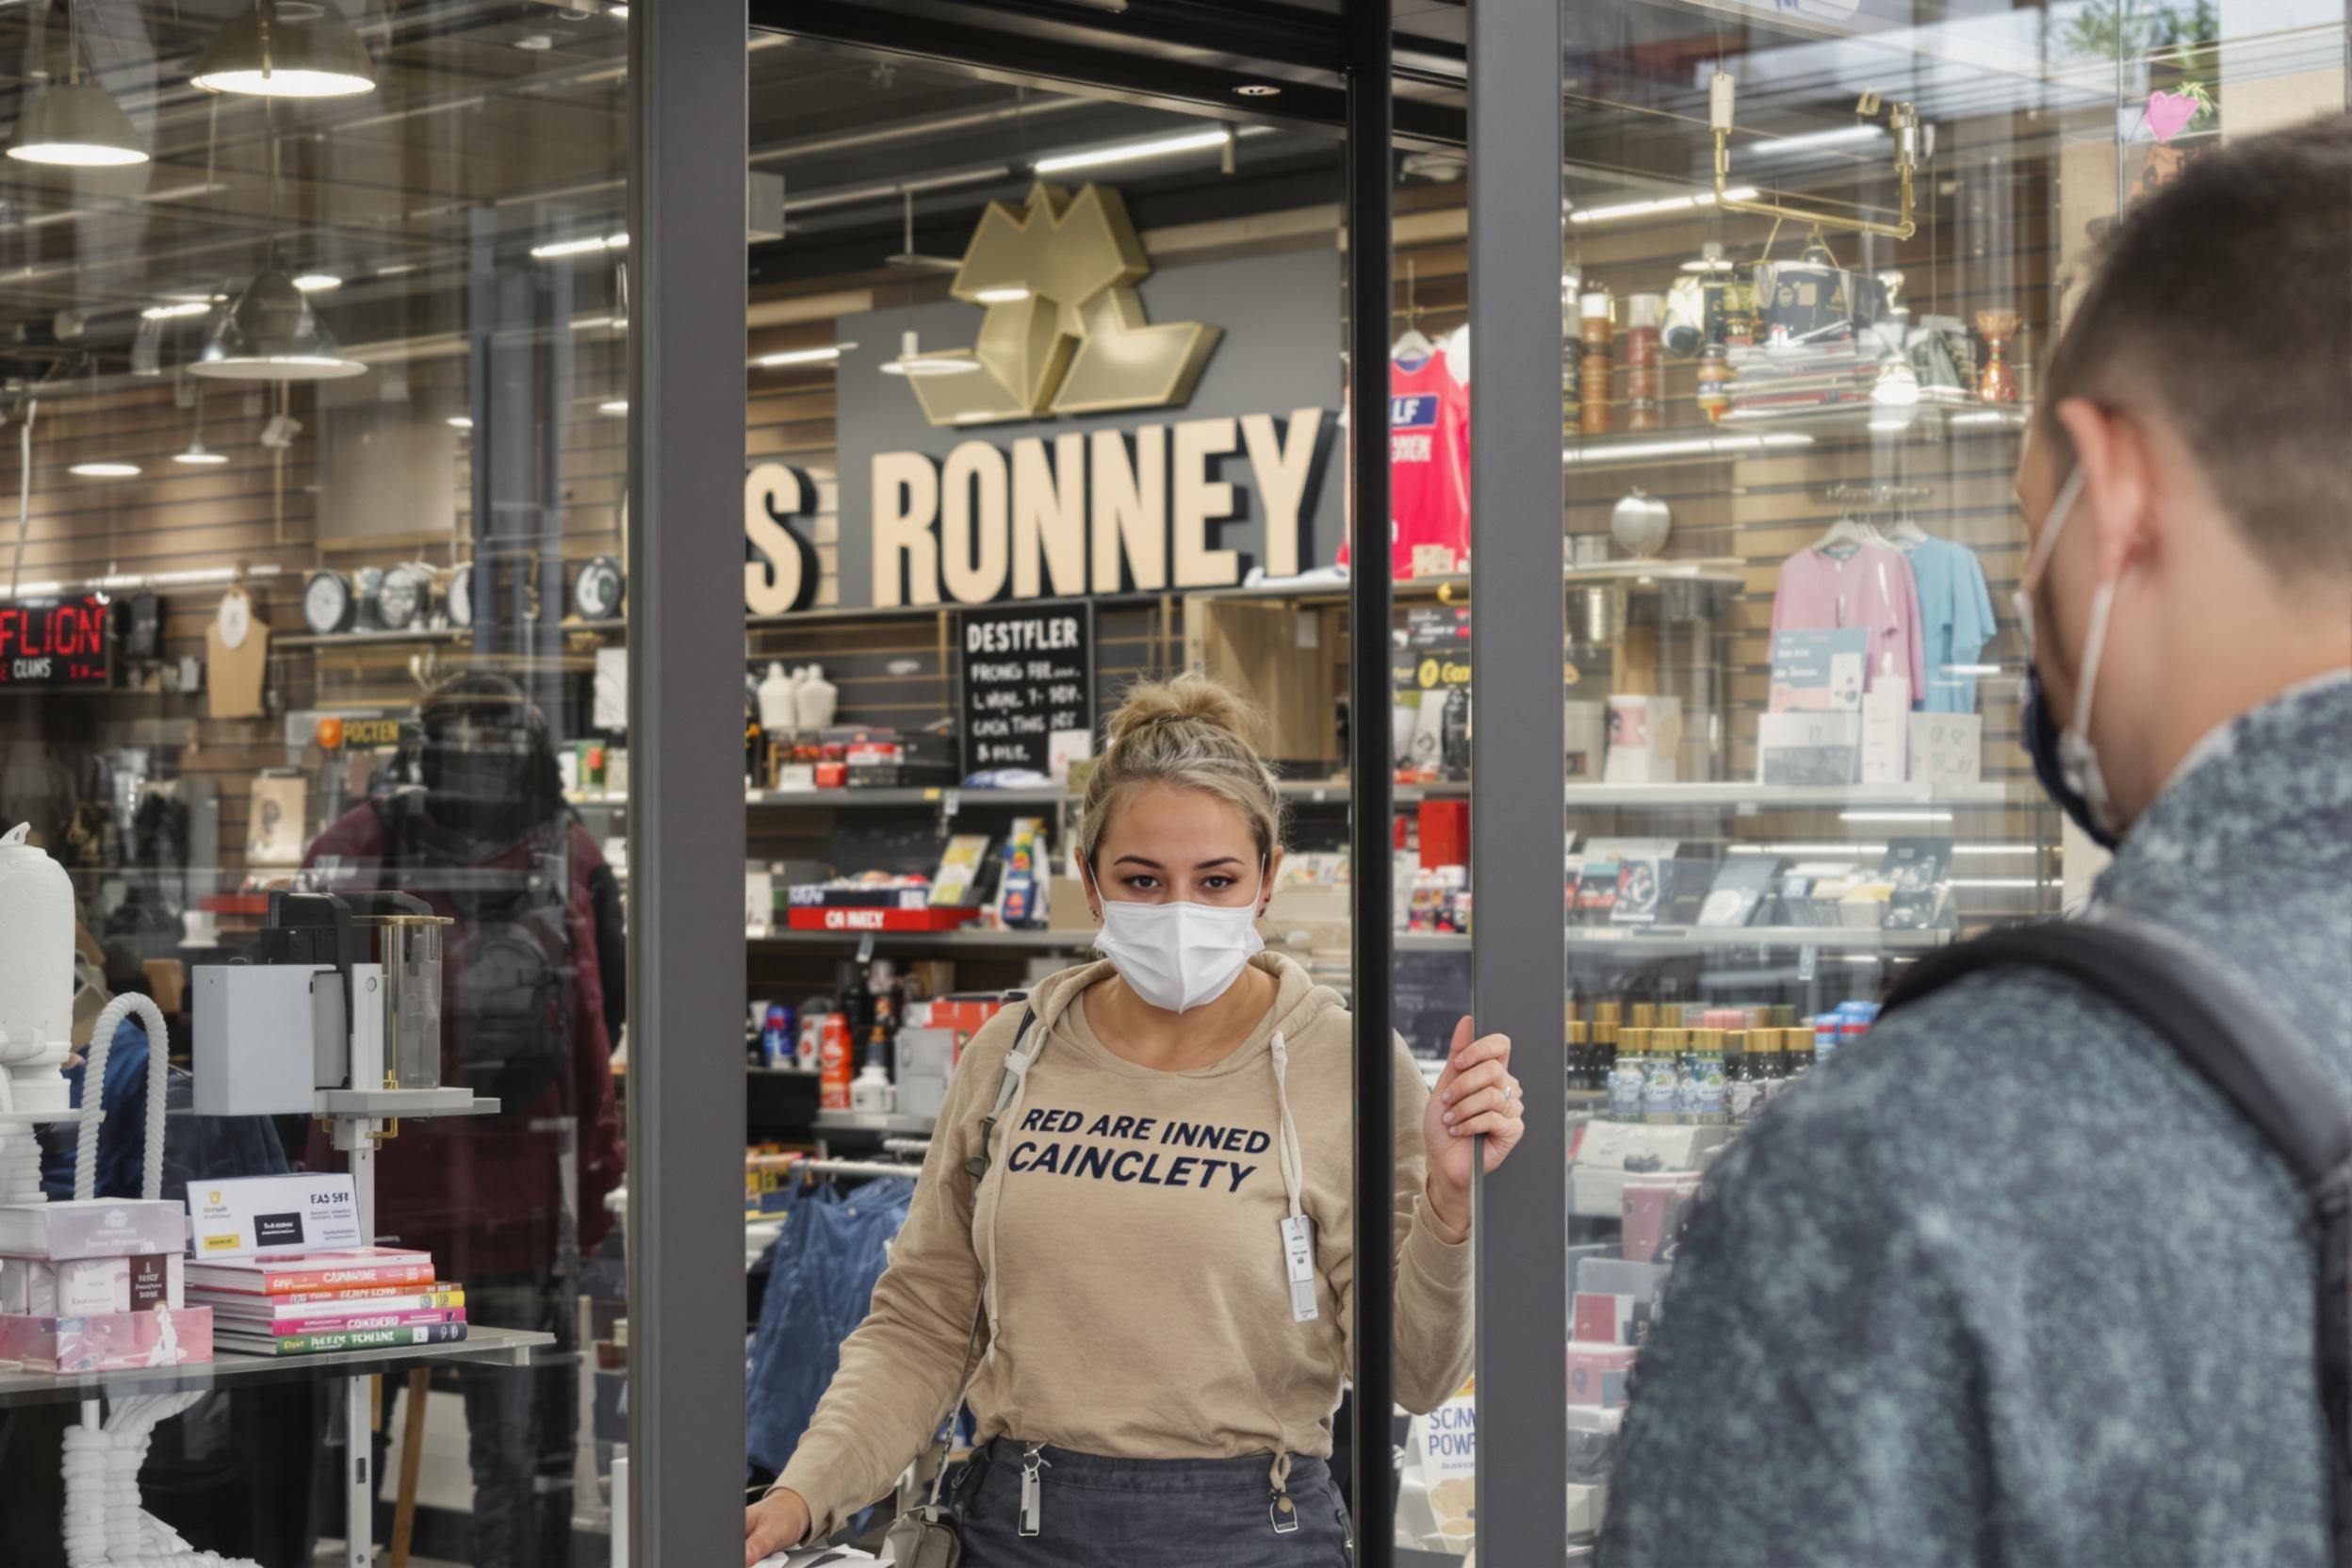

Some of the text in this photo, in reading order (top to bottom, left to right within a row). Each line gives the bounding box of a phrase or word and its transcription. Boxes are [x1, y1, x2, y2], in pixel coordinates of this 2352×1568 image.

[872, 408, 1323, 608] RONNEY
[1020, 1108, 1270, 1153] RED ARE INNED
[1008, 1141, 1258, 1193] CAINCLETY
